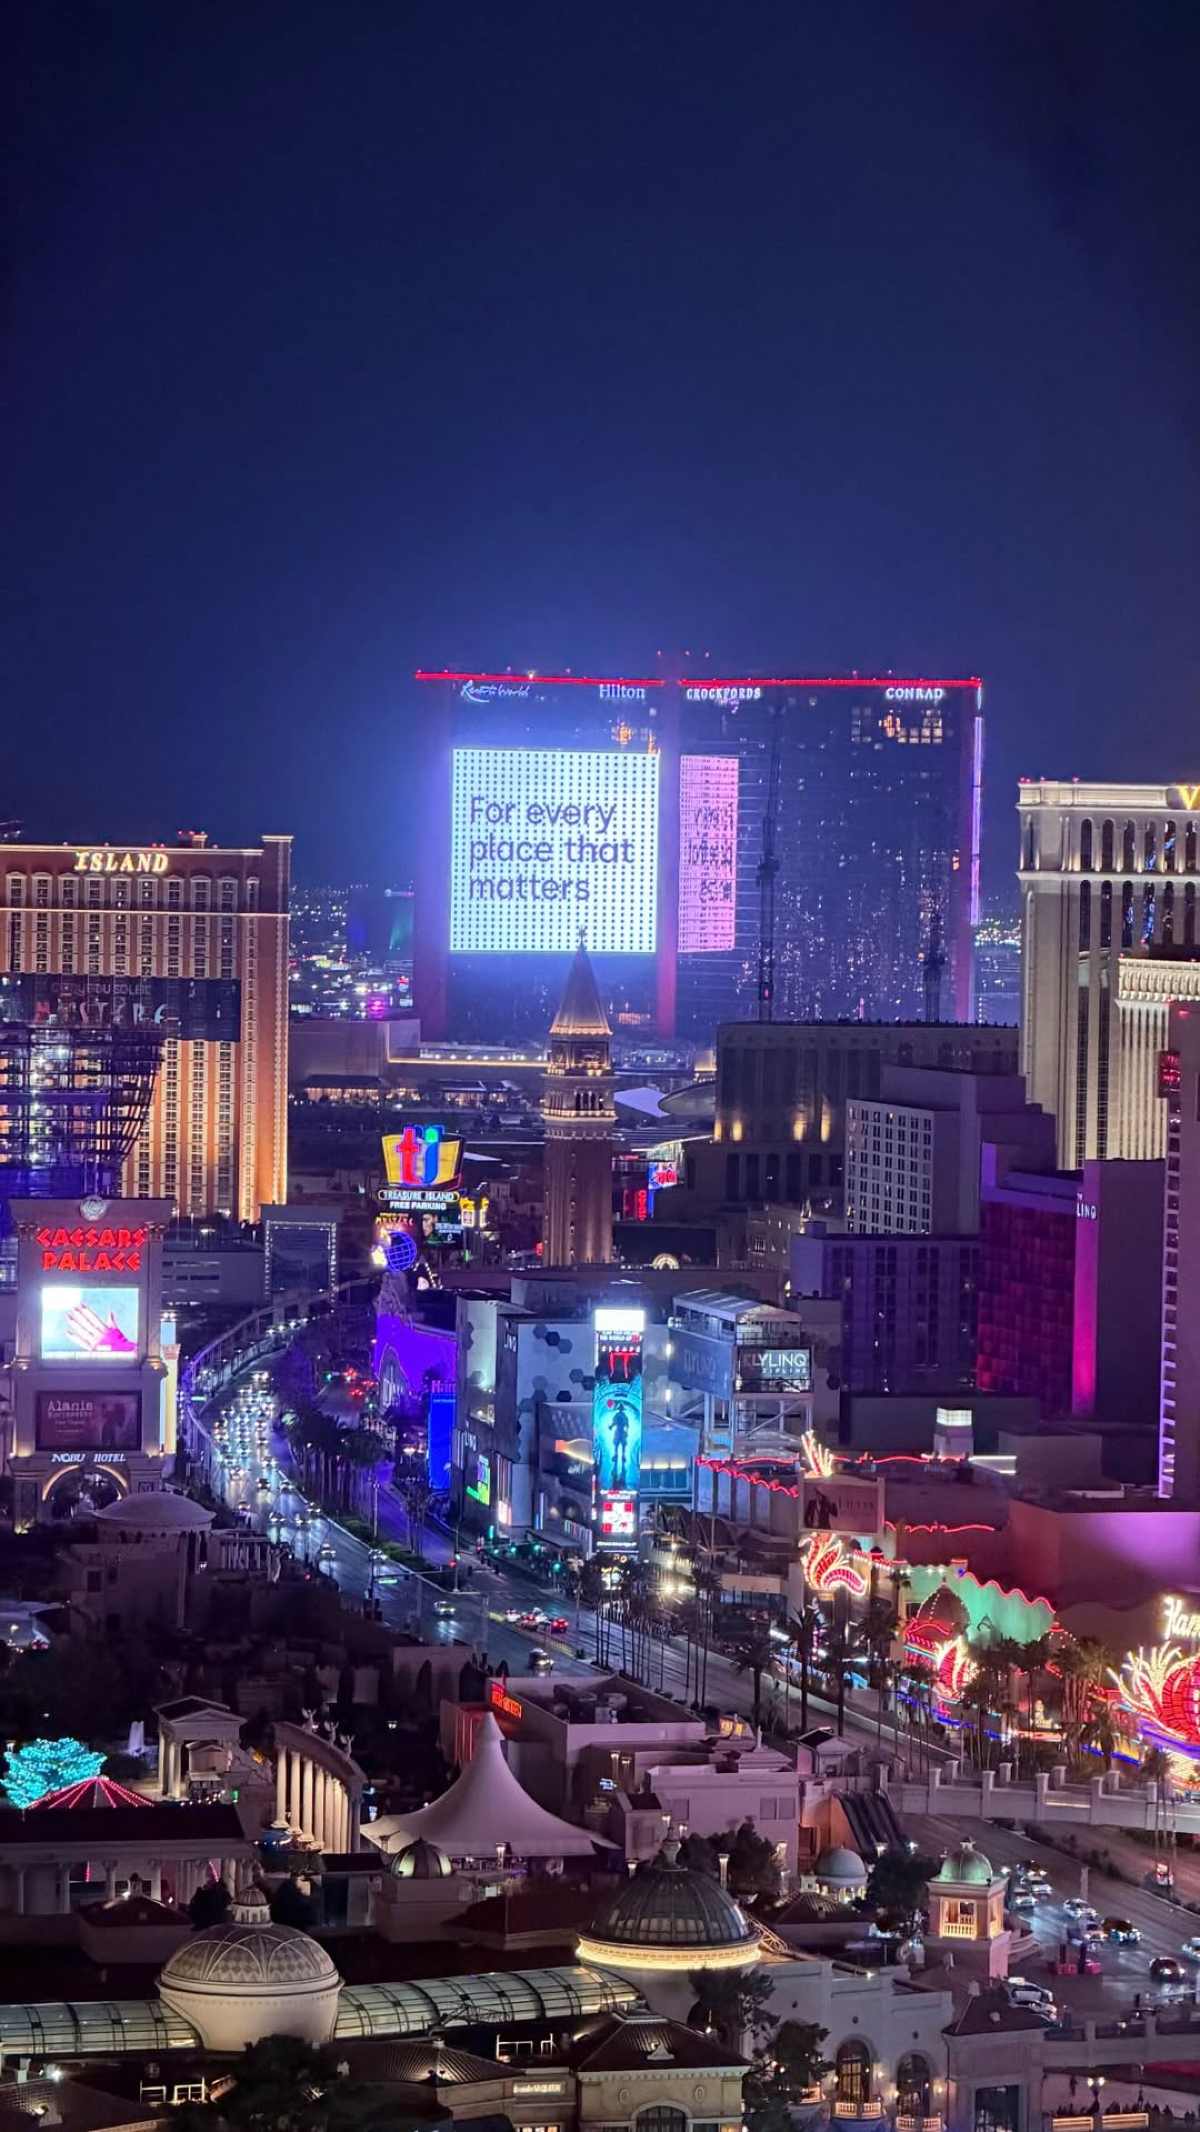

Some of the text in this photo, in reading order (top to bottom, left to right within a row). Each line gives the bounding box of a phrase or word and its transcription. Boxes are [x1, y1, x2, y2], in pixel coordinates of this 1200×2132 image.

[600, 684, 646, 700] Hilton
[686, 687, 762, 701] CROCKFORDS
[885, 687, 944, 701] CONRAD
[470, 795, 617, 834] For every
[469, 832, 635, 873] place that
[74, 851, 169, 873] ISLAND
[469, 873, 590, 901] matters
[383, 1191, 454, 1200] TREASURE ISLAND
[390, 1201, 447, 1210] FREE PARKING
[1076, 1203, 1097, 1219] LINQ
[37, 1229, 145, 1247] CAESARS
[42, 1252, 141, 1272] PALACE
[51, 1453, 127, 1463] NOBU HOTEL
